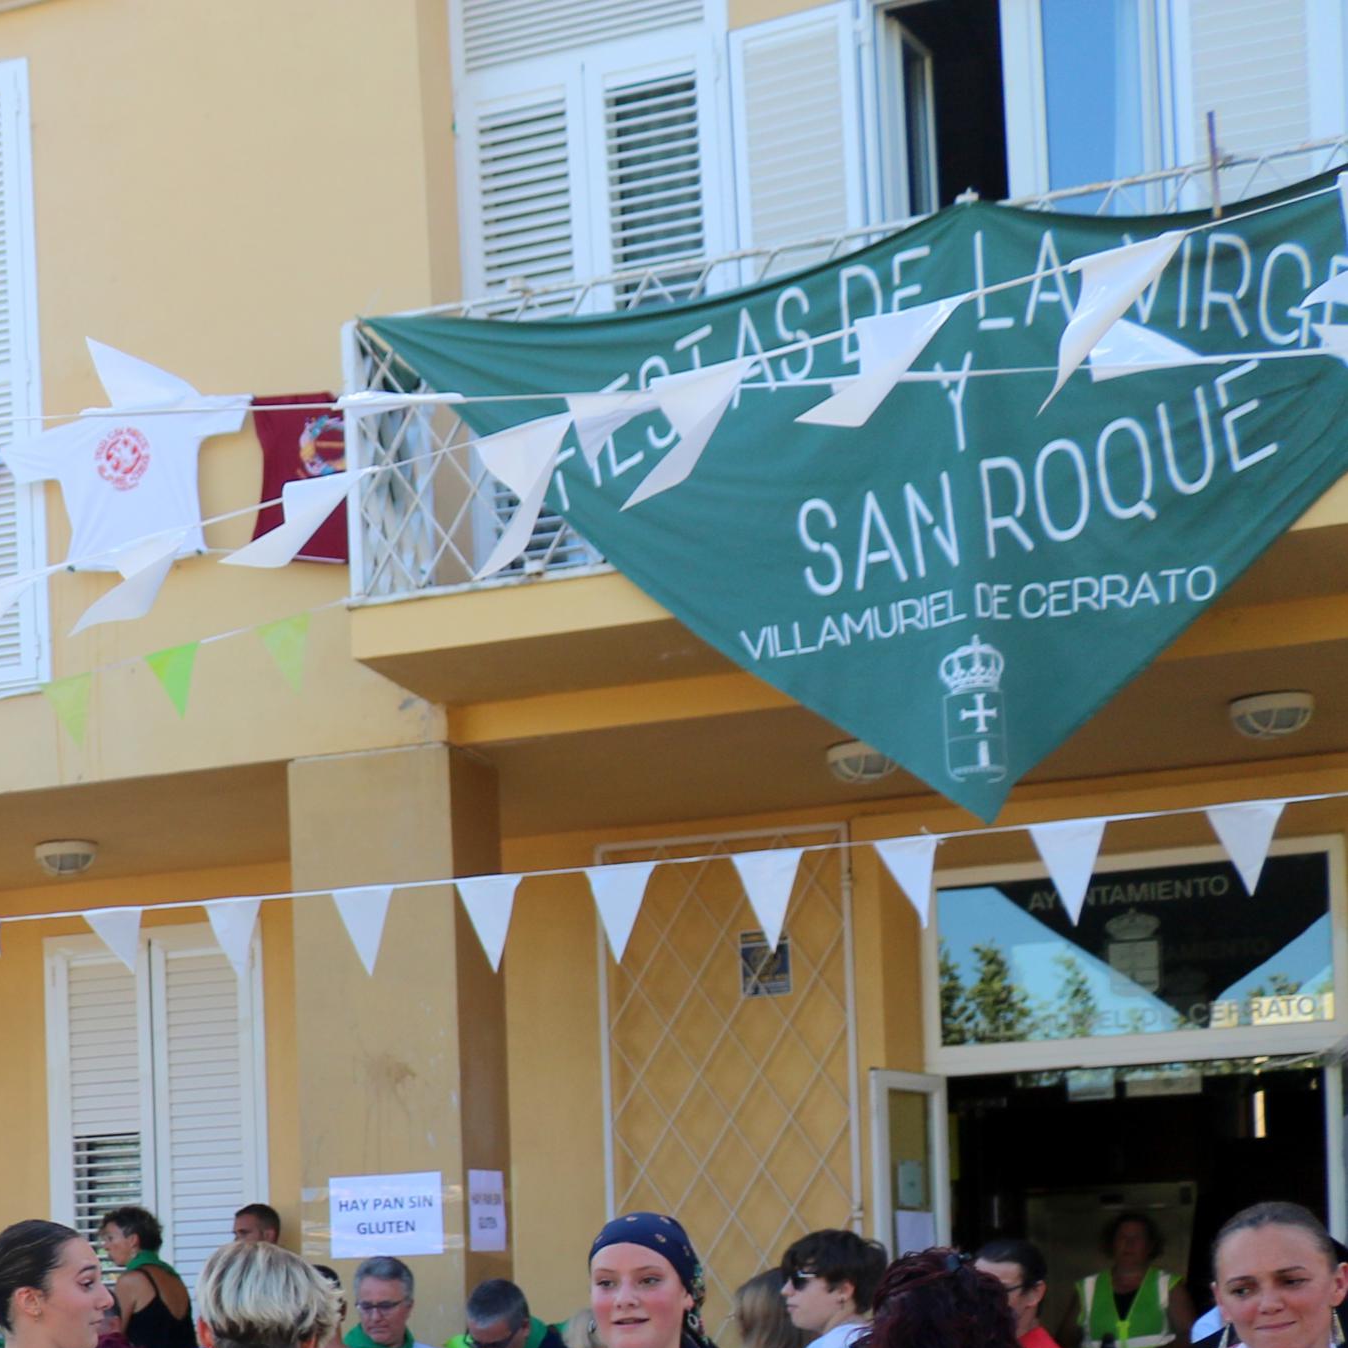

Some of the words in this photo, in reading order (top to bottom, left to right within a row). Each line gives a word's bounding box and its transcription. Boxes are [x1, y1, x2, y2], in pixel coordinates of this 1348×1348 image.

[839, 245, 931, 364] DE
[974, 229, 1075, 331] LA
[934, 350, 974, 453] Y
[796, 470, 962, 597] SAN
[978, 358, 1279, 560] ROQUE
[739, 589, 968, 662] VILLAMURIEL
[974, 582, 1013, 622] DE
[1017, 564, 1218, 620] CERRATO
[1027, 874, 1230, 912] AYNTAMIENTO
[338, 1199, 369, 1212] HAY
[372, 1196, 404, 1211] PAN
[409, 1194, 434, 1209] SIN
[356, 1220, 417, 1235] GLUTEN
